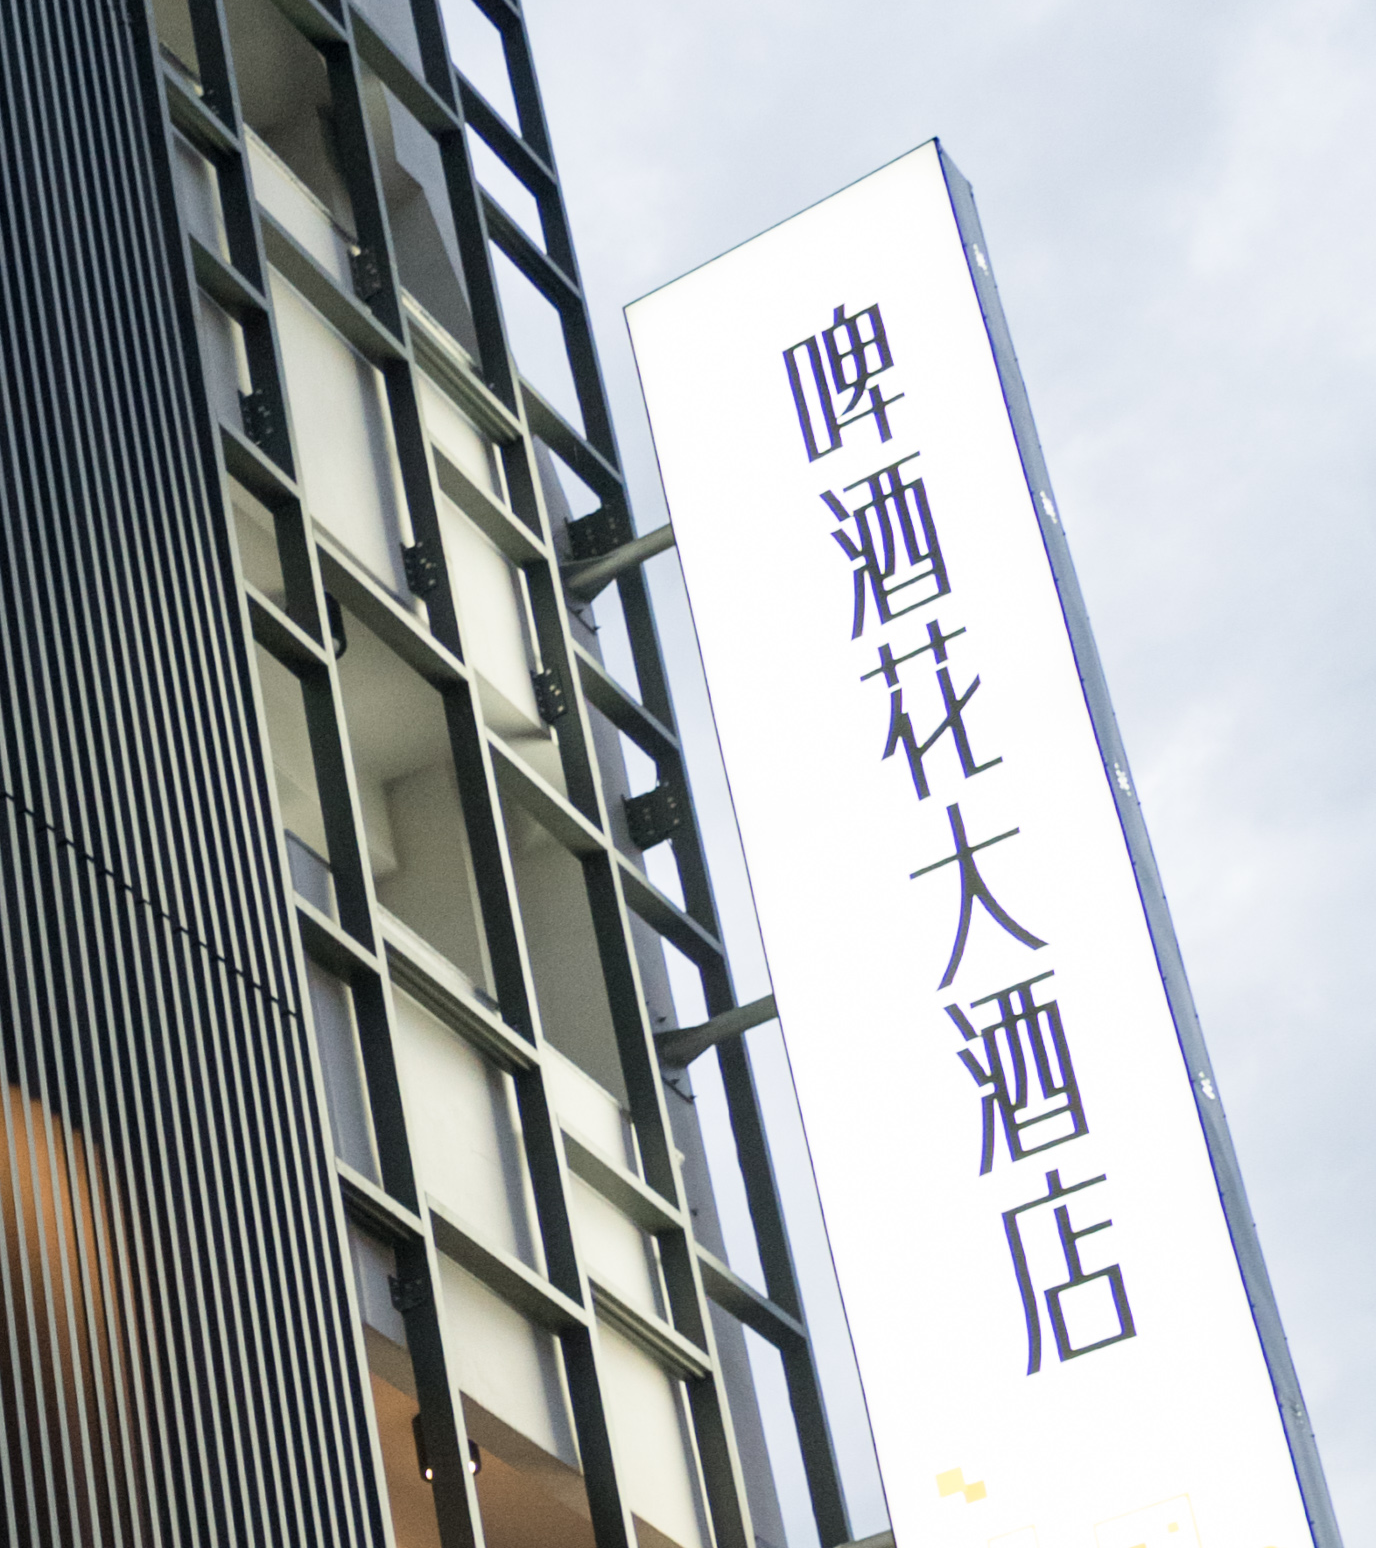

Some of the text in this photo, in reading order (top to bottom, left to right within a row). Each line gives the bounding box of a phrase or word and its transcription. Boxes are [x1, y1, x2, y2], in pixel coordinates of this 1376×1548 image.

[783, 303, 1138, 1376] 啤酒花大酒店
